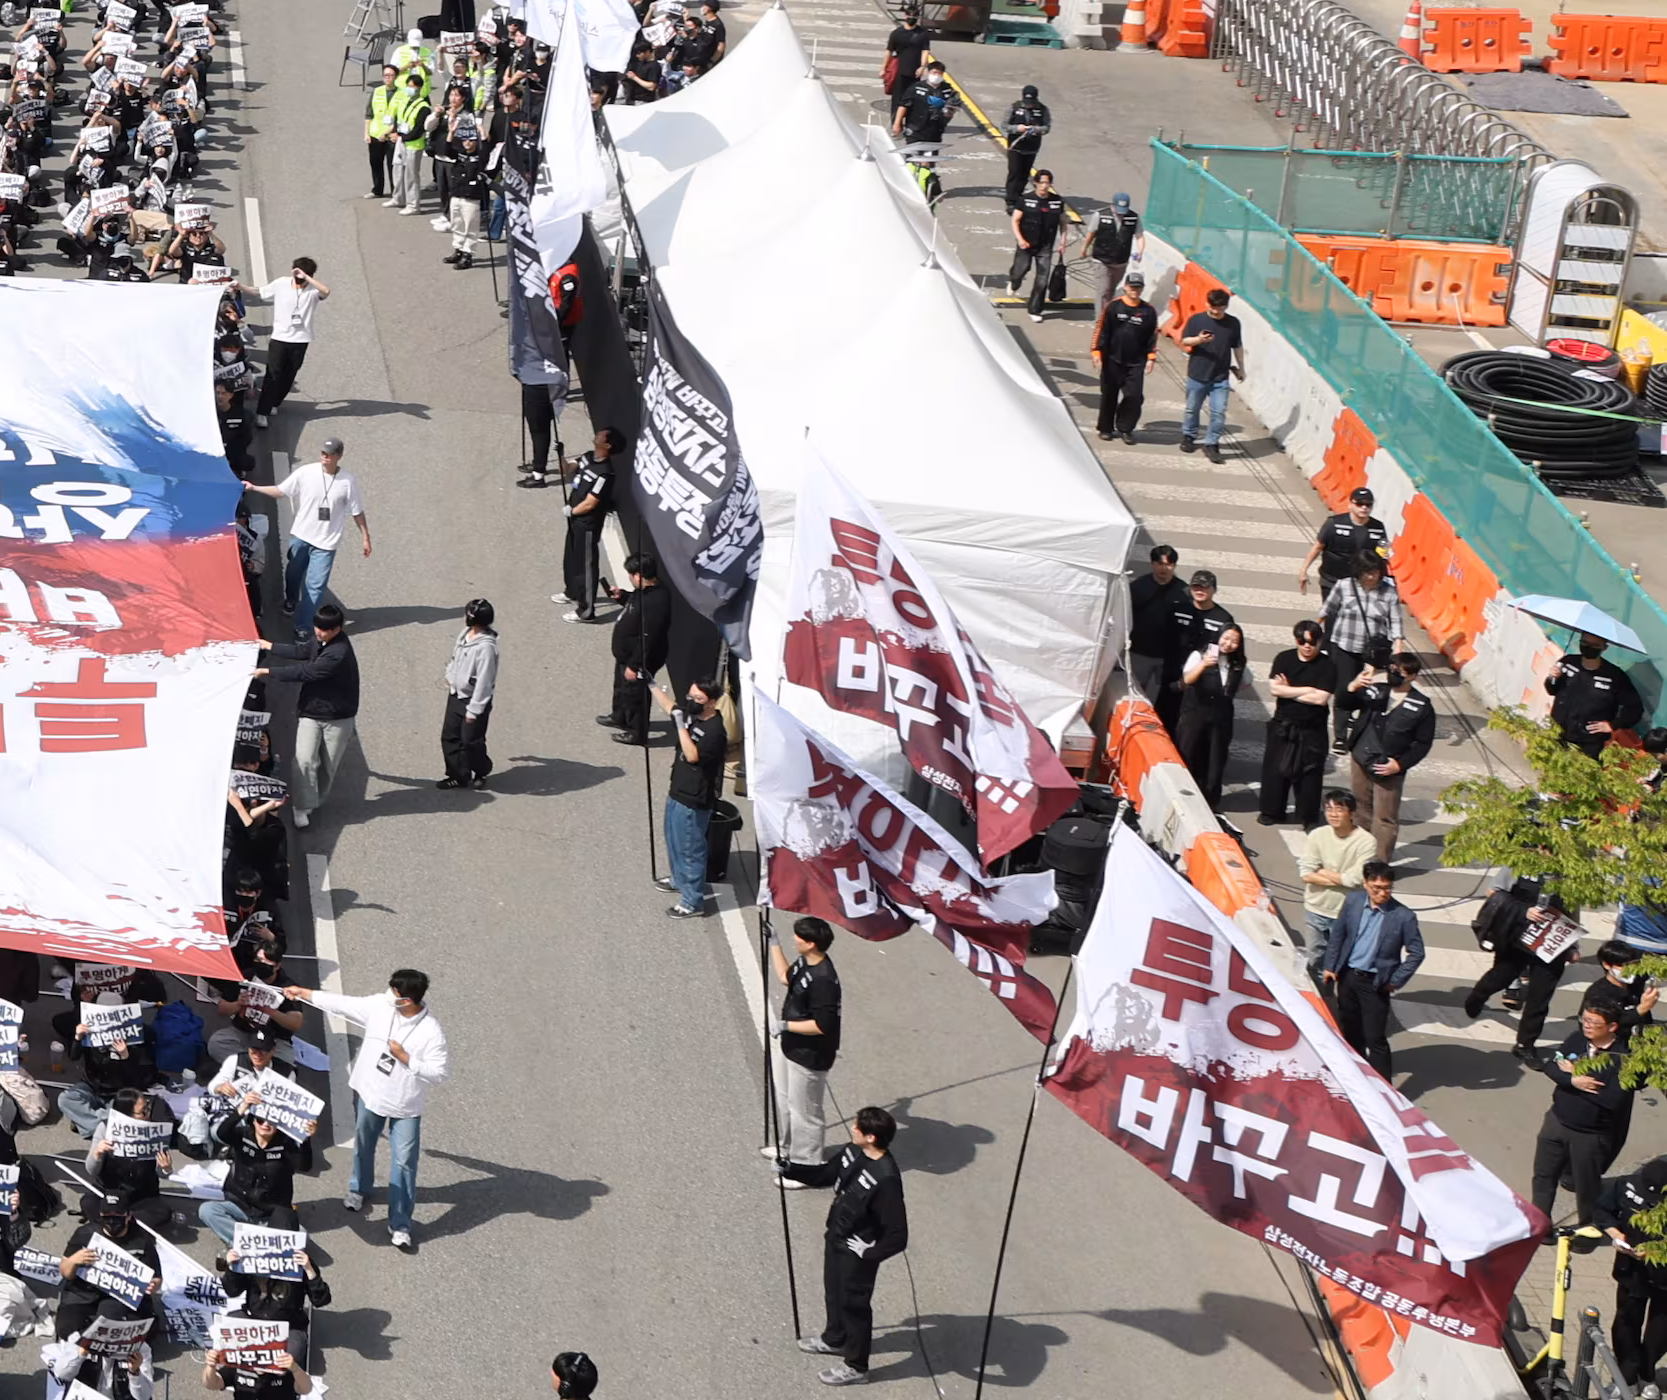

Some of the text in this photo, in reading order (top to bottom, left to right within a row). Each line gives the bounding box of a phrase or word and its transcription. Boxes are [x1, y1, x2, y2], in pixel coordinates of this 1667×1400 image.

[86, 1008, 136, 1030] 상한폐지
[262, 1081, 313, 1113] 상한폐지
[112, 1121, 165, 1140] 상한폐지
[240, 1233, 301, 1251] 상한폐지
[93, 1245, 146, 1278] 상한폐지
[241, 1255, 301, 1274] 실현하자
[83, 1268, 141, 1299] 실현하자
[1264, 1224, 1478, 1338] 삼성전자노동조합 공동투쟁본부
[95, 1320, 148, 1343] 투명하게
[221, 1325, 280, 1343] 투명하게
[225, 1347, 285, 1368] 바꾸고!!!
